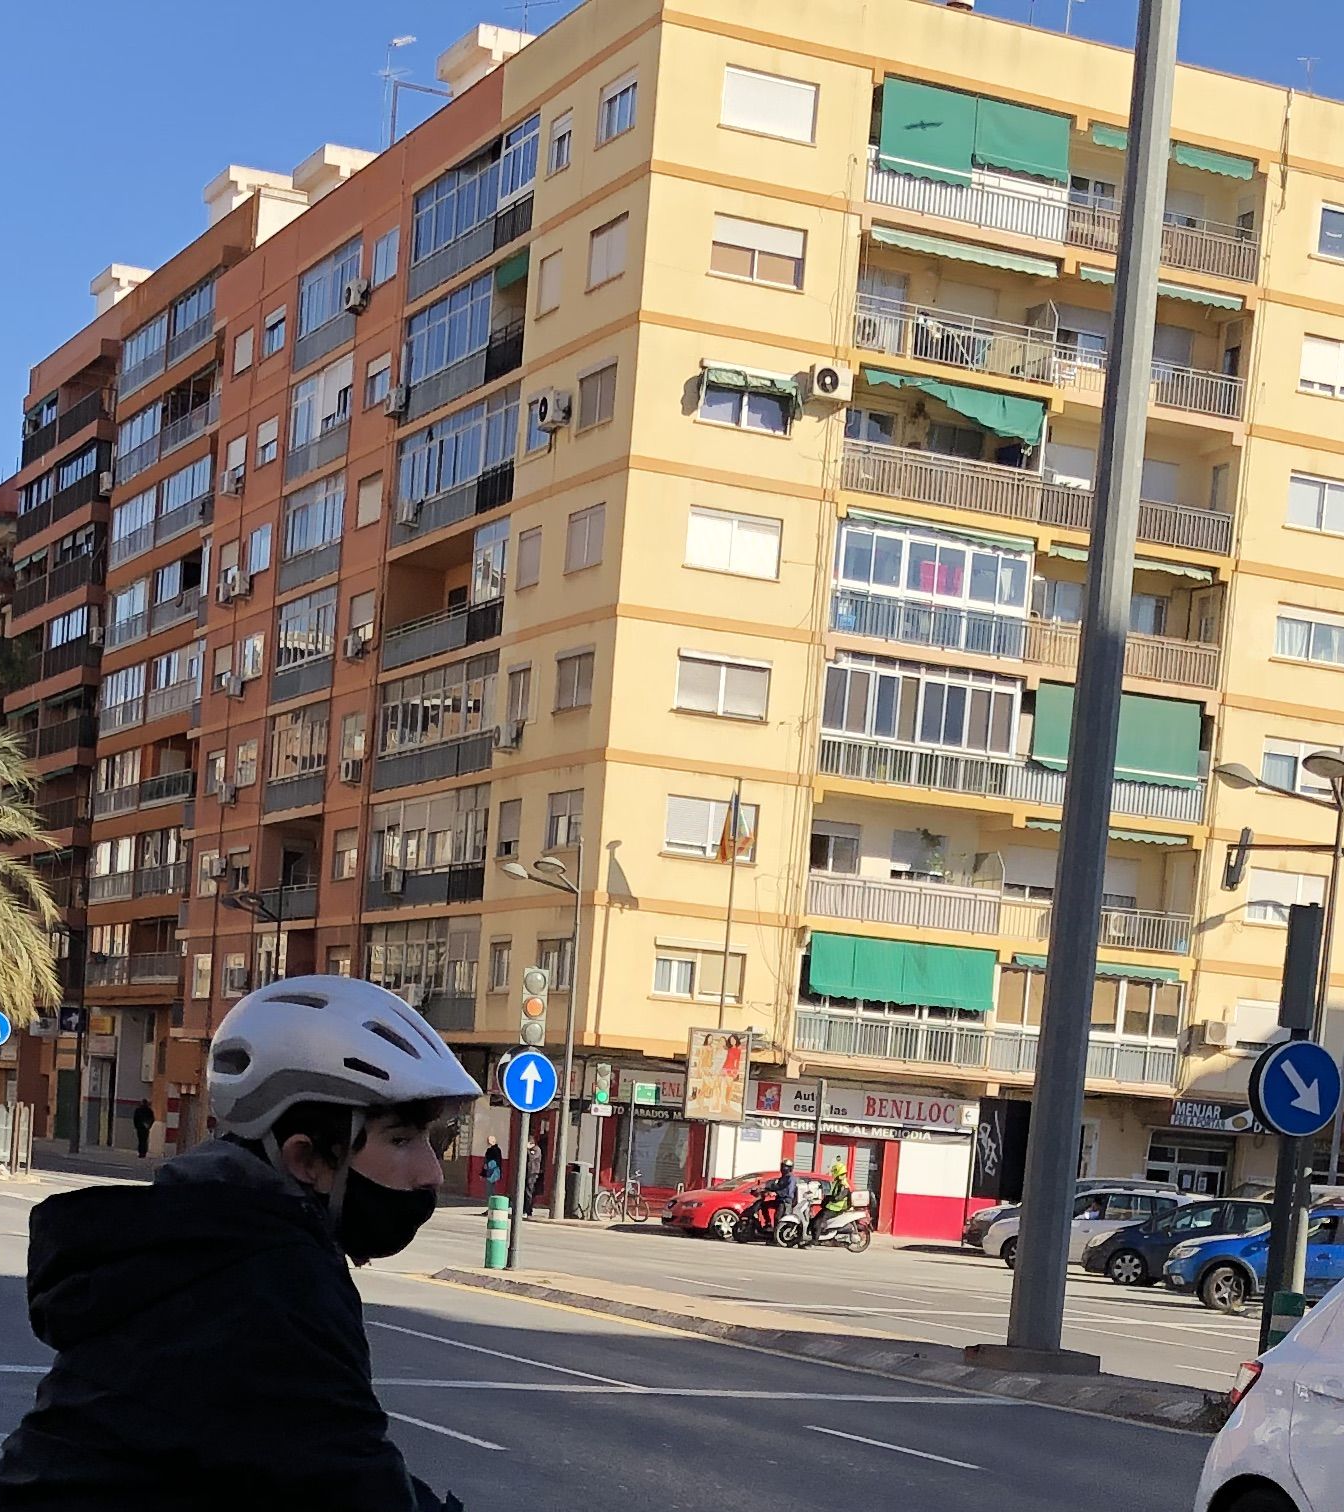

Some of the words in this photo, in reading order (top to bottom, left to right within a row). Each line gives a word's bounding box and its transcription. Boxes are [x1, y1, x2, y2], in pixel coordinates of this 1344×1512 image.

[794, 1090, 816, 1102] Aut
[793, 1103, 848, 1116] esclas
[864, 1095, 955, 1124] BENLLOC
[1175, 1101, 1222, 1119] MENJAR
[761, 1117, 781, 1129] NO
[854, 1126, 869, 1136] AL
